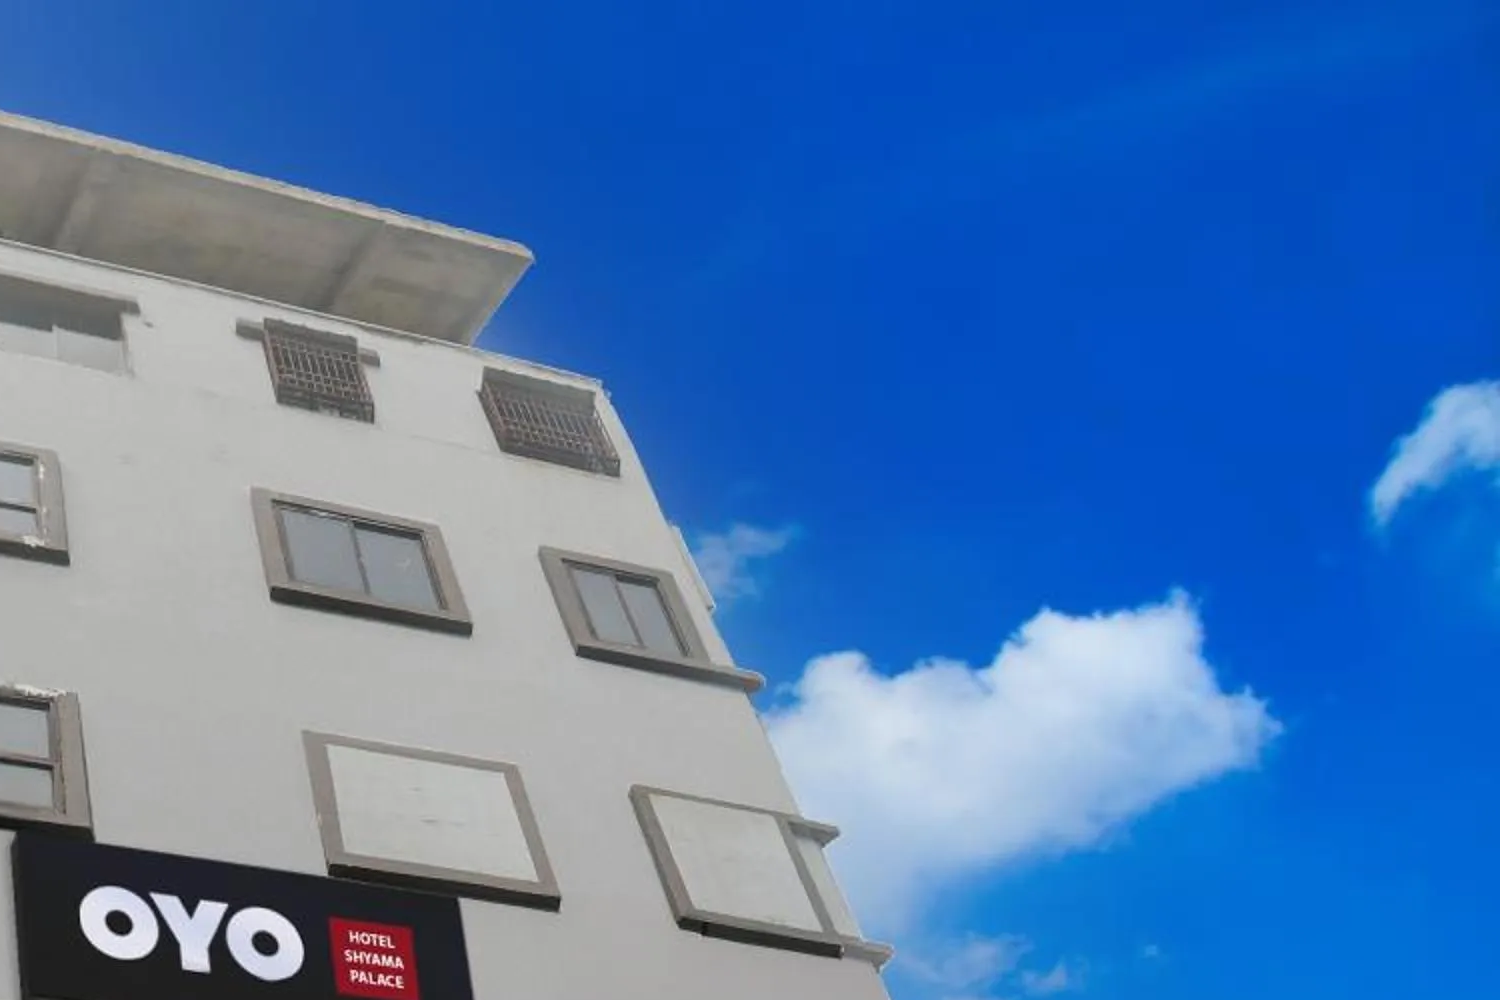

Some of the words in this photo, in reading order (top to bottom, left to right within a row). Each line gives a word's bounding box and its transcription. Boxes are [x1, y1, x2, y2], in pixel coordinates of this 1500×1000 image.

[79, 885, 305, 982] OYO
[348, 930, 396, 949] HOTEL
[343, 949, 405, 970] SHYAMA
[349, 969, 405, 989] PALACE
